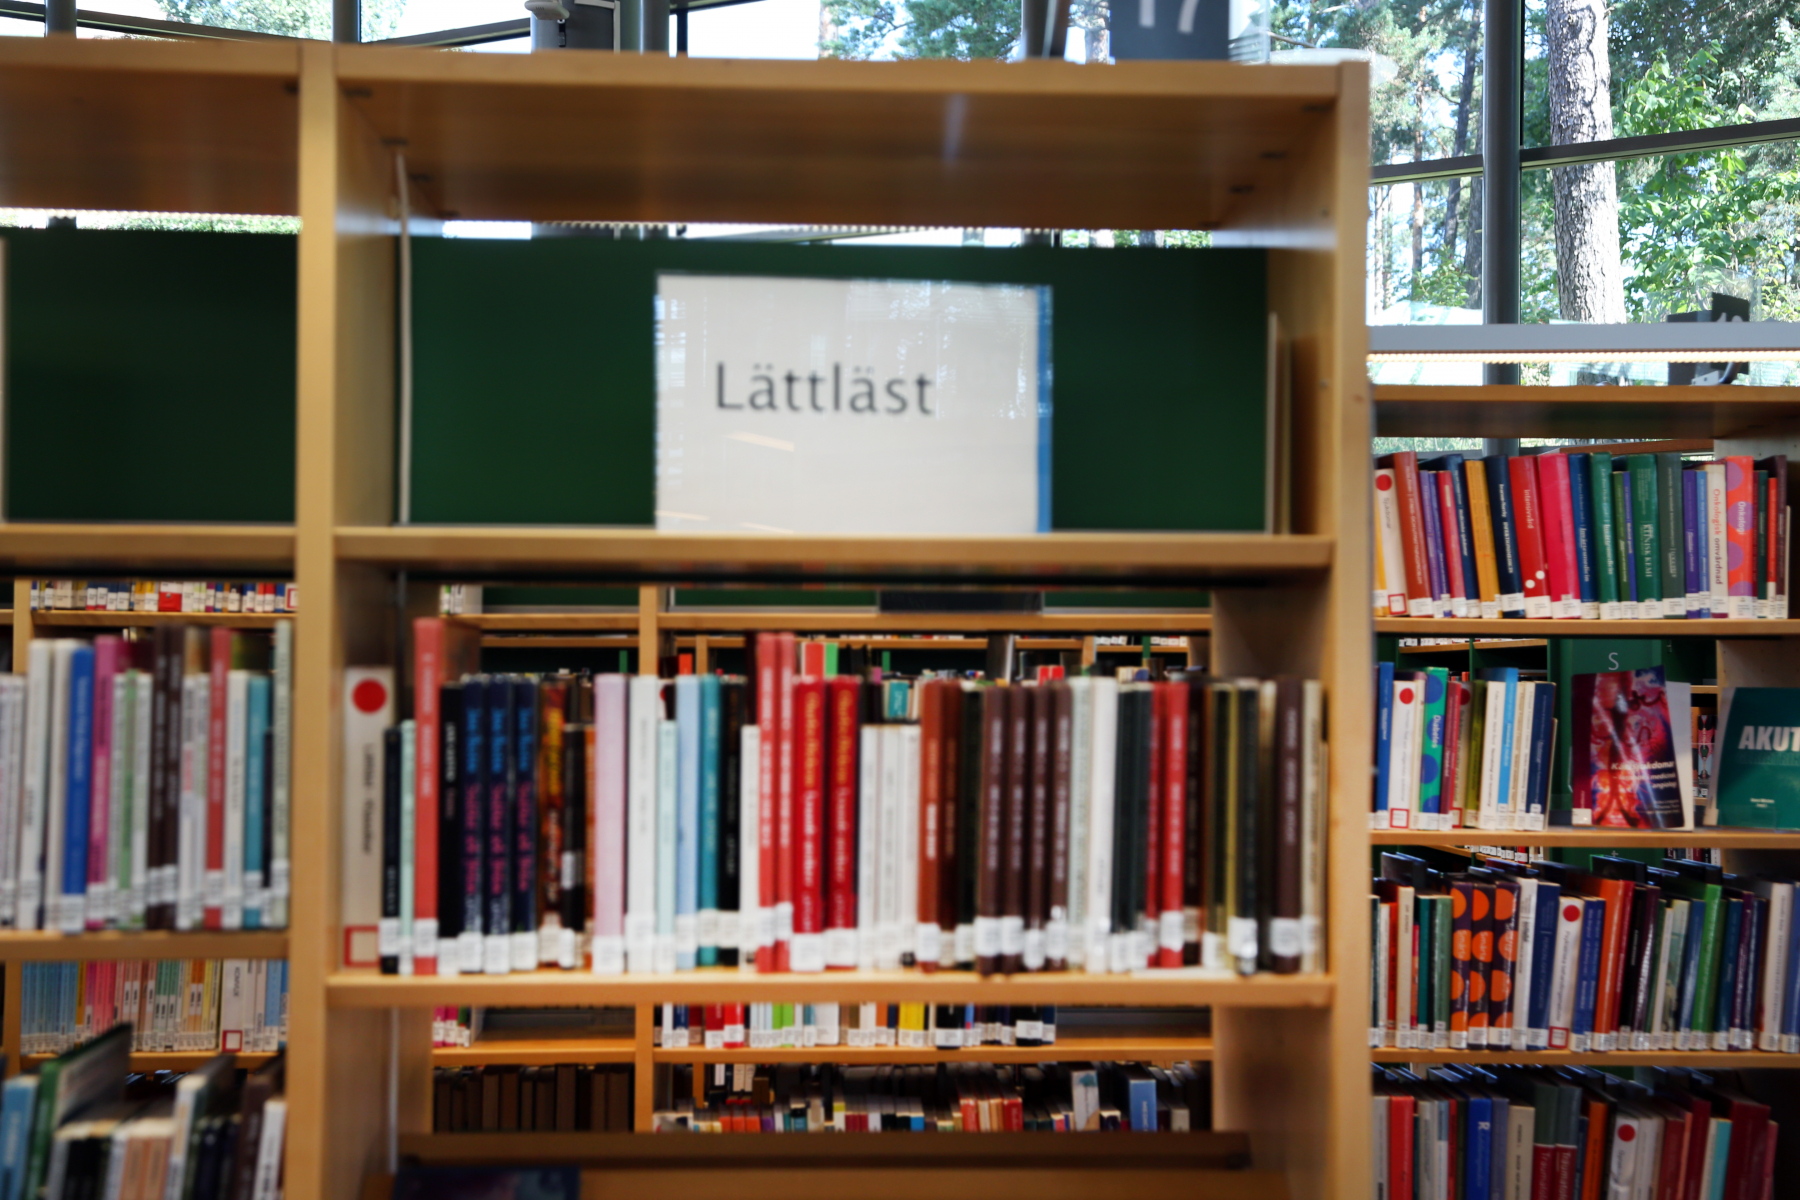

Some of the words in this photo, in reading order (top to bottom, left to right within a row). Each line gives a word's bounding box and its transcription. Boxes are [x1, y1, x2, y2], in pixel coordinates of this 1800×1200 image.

[715, 361, 935, 415] Lättläst
[1524, 489, 1534, 529] Intensivvård
[1712, 489, 1722, 535] Onkologisk
[1736, 501, 1746, 535] Onkologi
[1580, 528, 1590, 582] Invärtesmedicin
[1603, 524, 1613, 575] Invärtesmedicin
[1643, 524, 1652, 555] KLINISK
[1644, 557, 1652, 577] KEMI
[1714, 538, 1722, 585] omvårdnad
[1608, 652, 1619, 671] S
[1431, 715, 1441, 748] Diabetes
[1458, 930, 1468, 959] Smärta
[1479, 931, 1489, 960] Smärta
